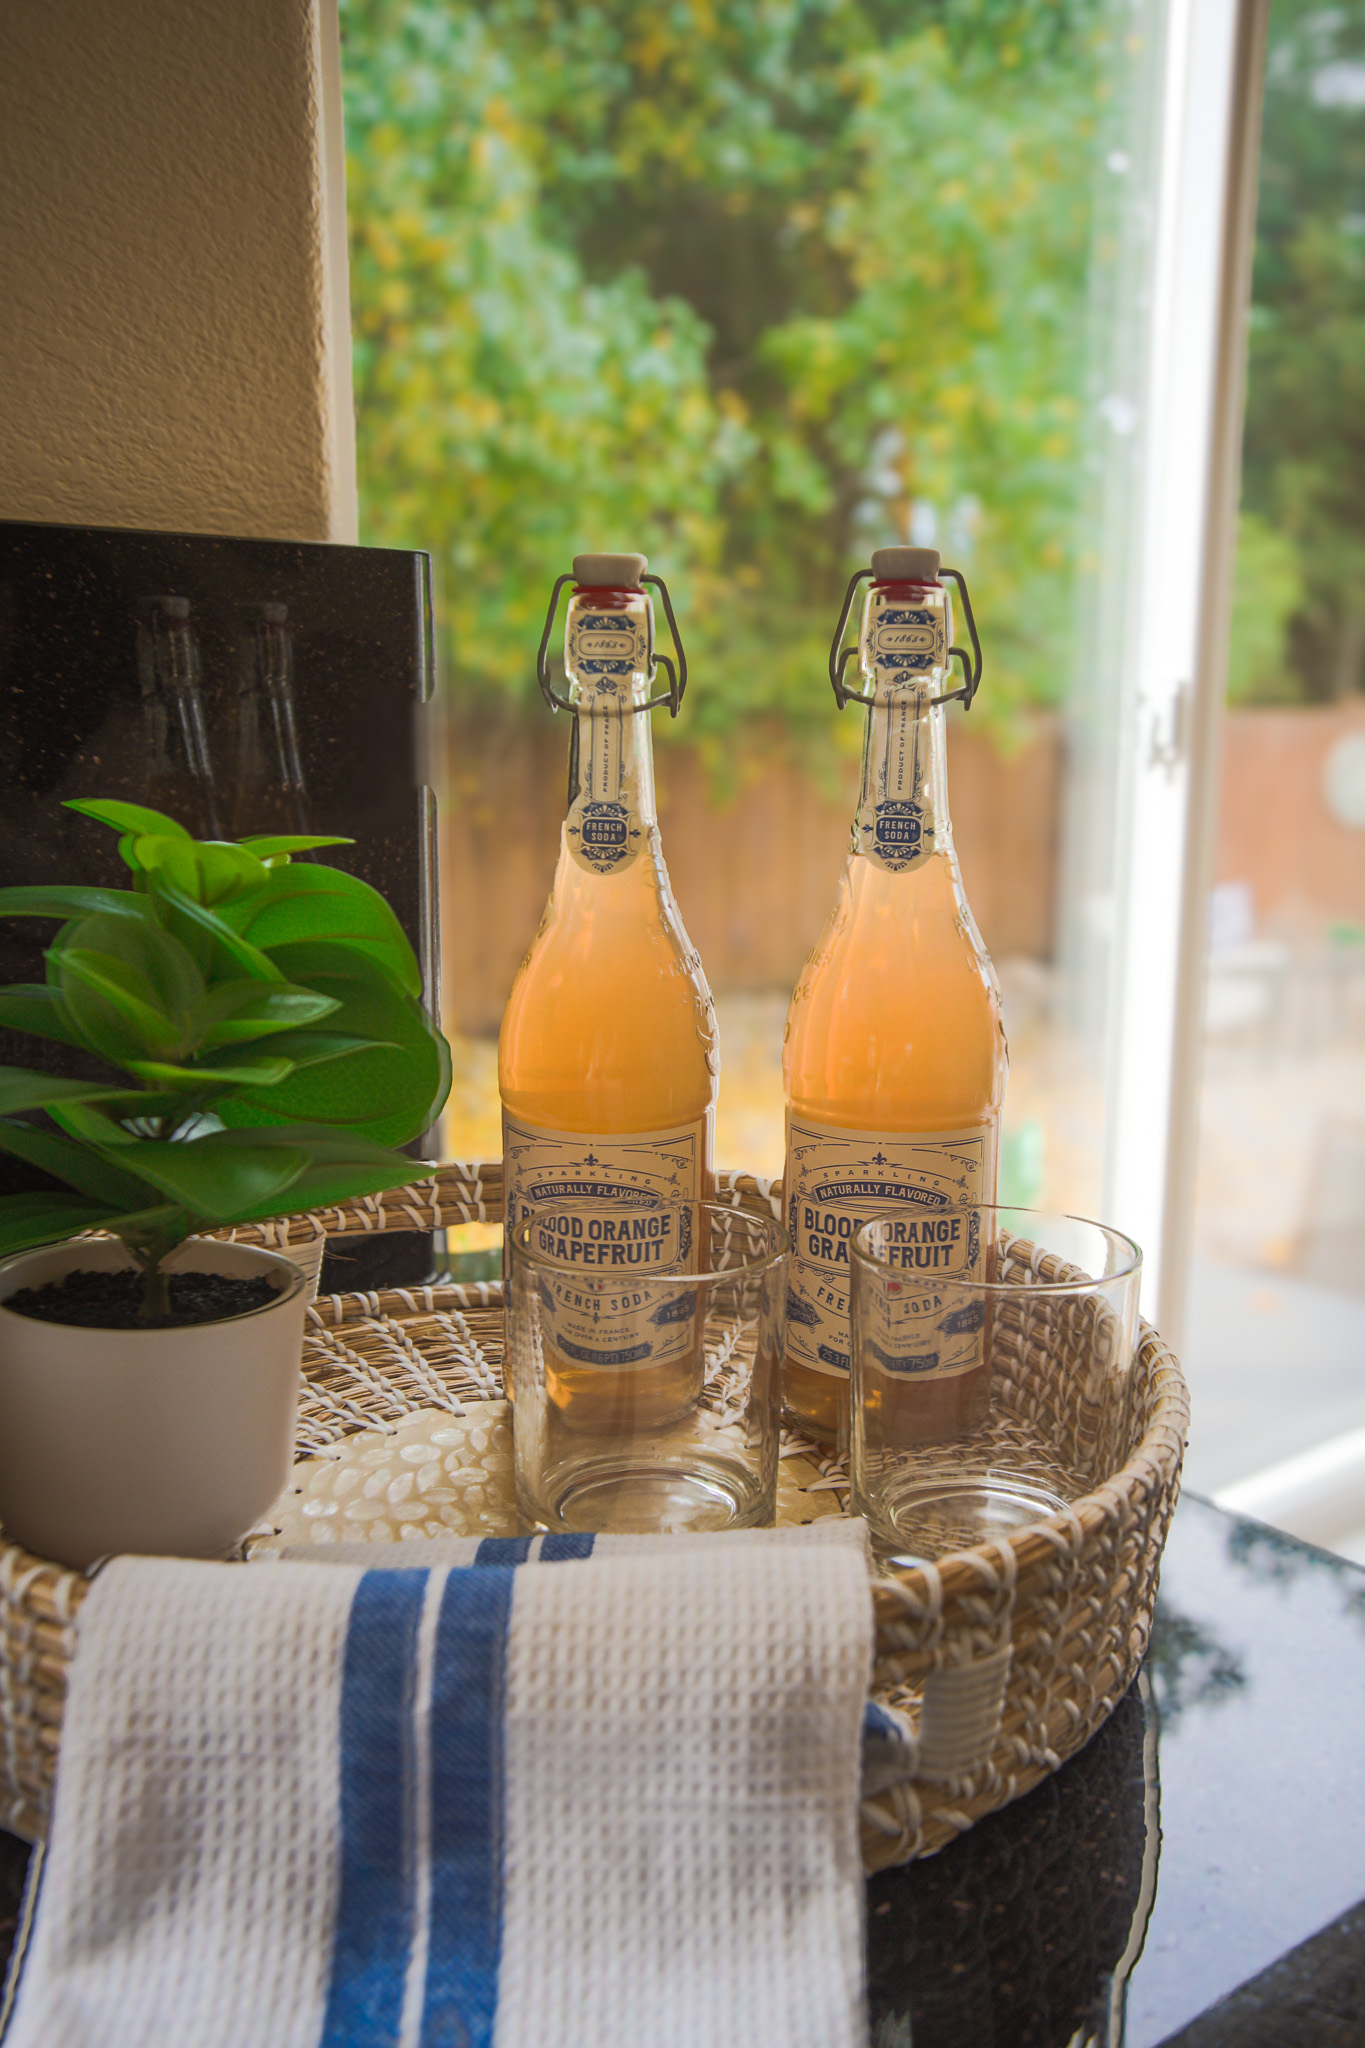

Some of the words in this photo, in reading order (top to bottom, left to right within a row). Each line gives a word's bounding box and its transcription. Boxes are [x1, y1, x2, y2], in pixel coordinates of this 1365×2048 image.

[604, 738, 609, 749] OF
[899, 737, 905, 748] OF
[586, 823, 623, 832] FRENCH
[879, 820, 916, 830] FRENCH
[590, 832, 616, 842] SODA
[884, 830, 910, 840] SODA
[537, 1170, 651, 1185] SPARKLING
[823, 1169, 941, 1186] SPARKLING
[534, 1185, 592, 1198] NATURALLY
[820, 1184, 880, 1199] NATURALLY
[884, 1185, 941, 1205] FLAVORED
[588, 1214, 671, 1241] ORANGE
[883, 1218, 961, 1243] ORANGE
[539, 1232, 664, 1265] GRAPEFRUIT
[809, 1234, 954, 1270] GRAFRUIT
[552, 1280, 601, 1311] FRENCH
[611, 1290, 652, 1311] SODA
[903, 1295, 942, 1314] SODA
[567, 1321, 586, 1333] MADE
[957, 1315, 979, 1329] 1865
[574, 1331, 593, 1341] OVER
[602, 1332, 640, 1343] CENTURY
[828, 1335, 844, 1344] FOR
[821, 1348, 840, 1364] 25.3
